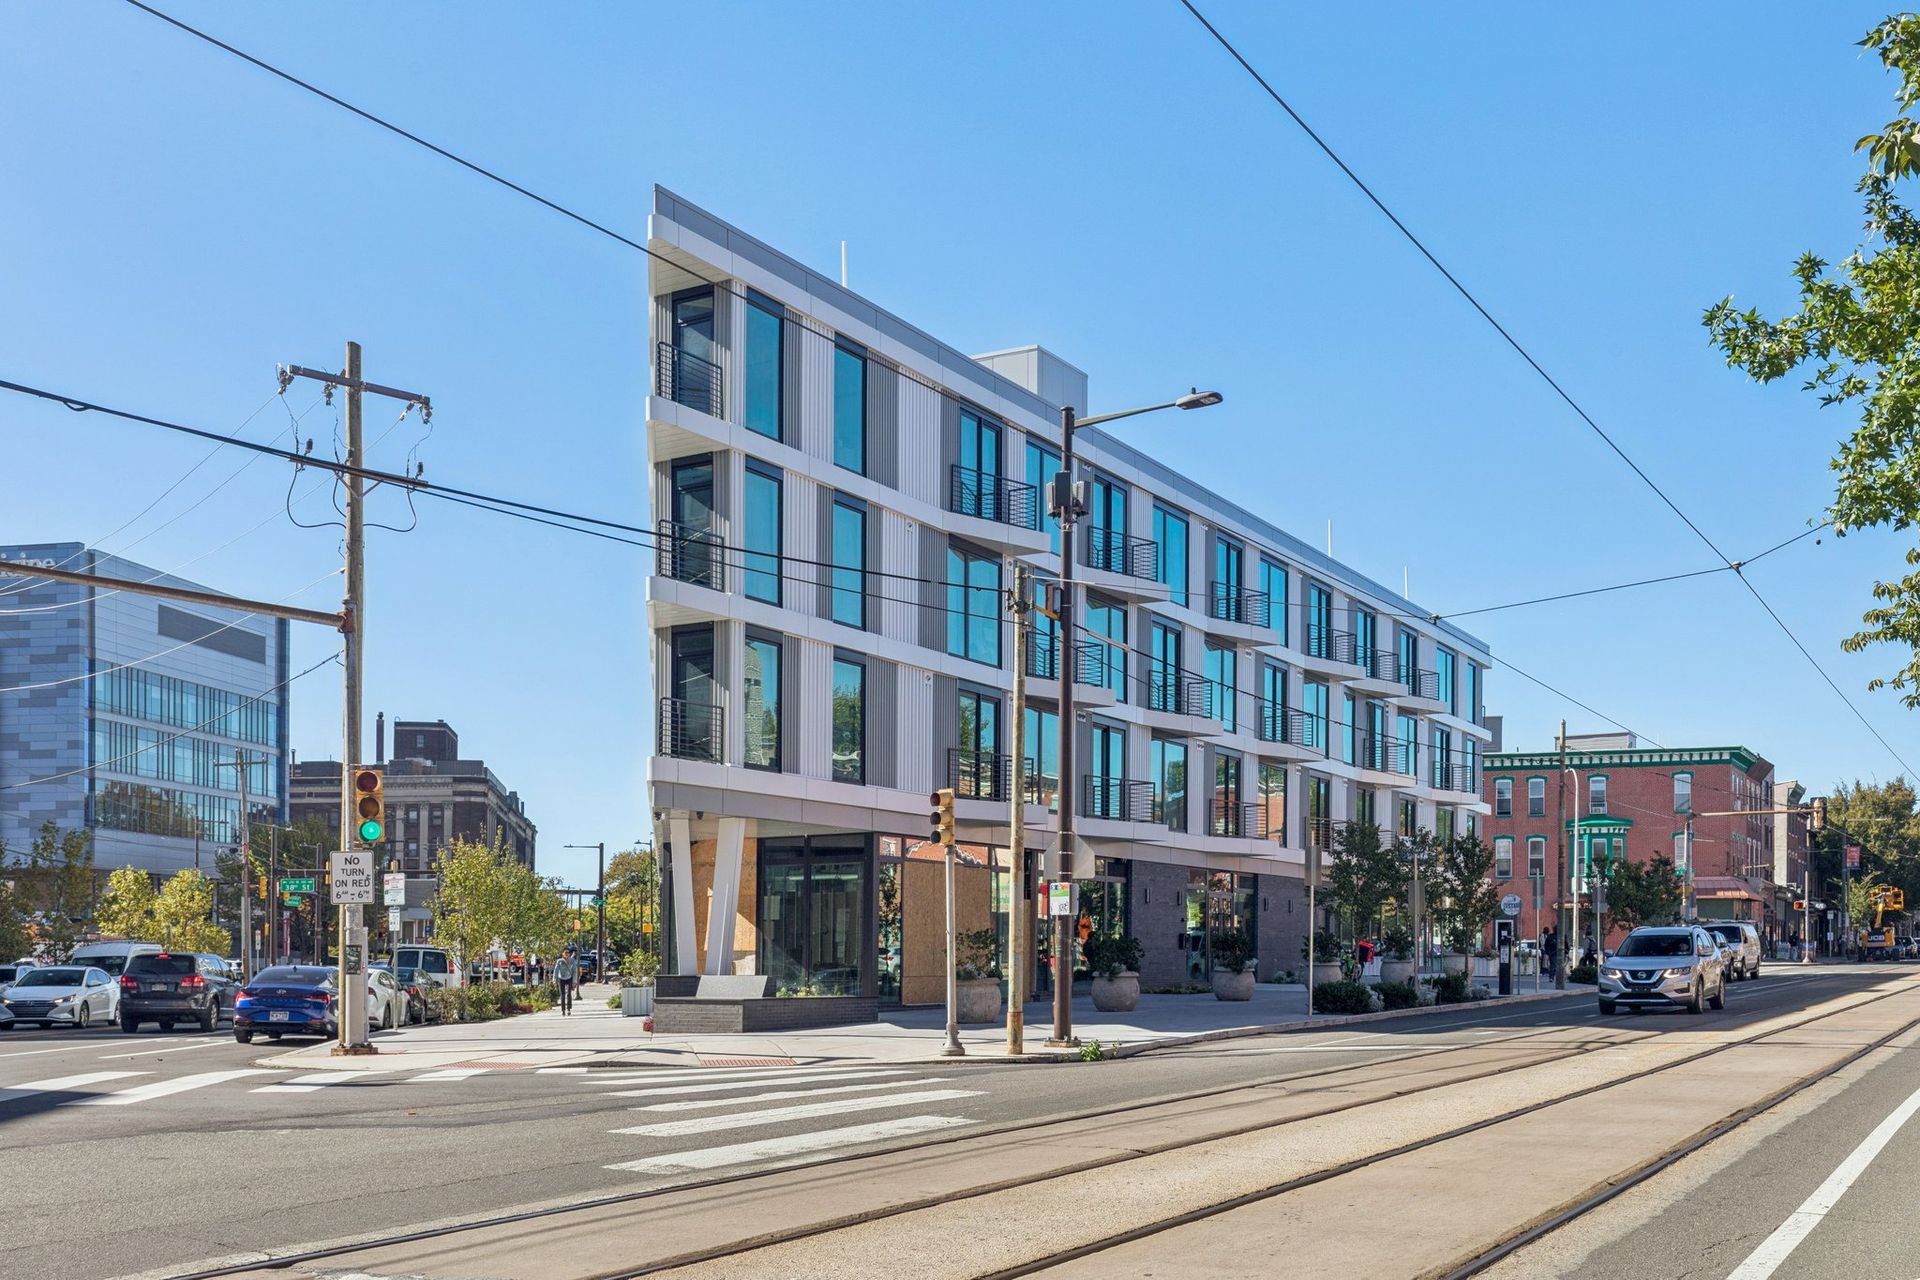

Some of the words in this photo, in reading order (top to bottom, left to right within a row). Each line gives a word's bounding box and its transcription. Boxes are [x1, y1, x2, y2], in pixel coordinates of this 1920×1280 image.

[344, 857, 360, 865] NO
[341, 868, 364, 876] TURN
[335, 879, 348, 888] ON
[352, 879, 371, 888] RED
